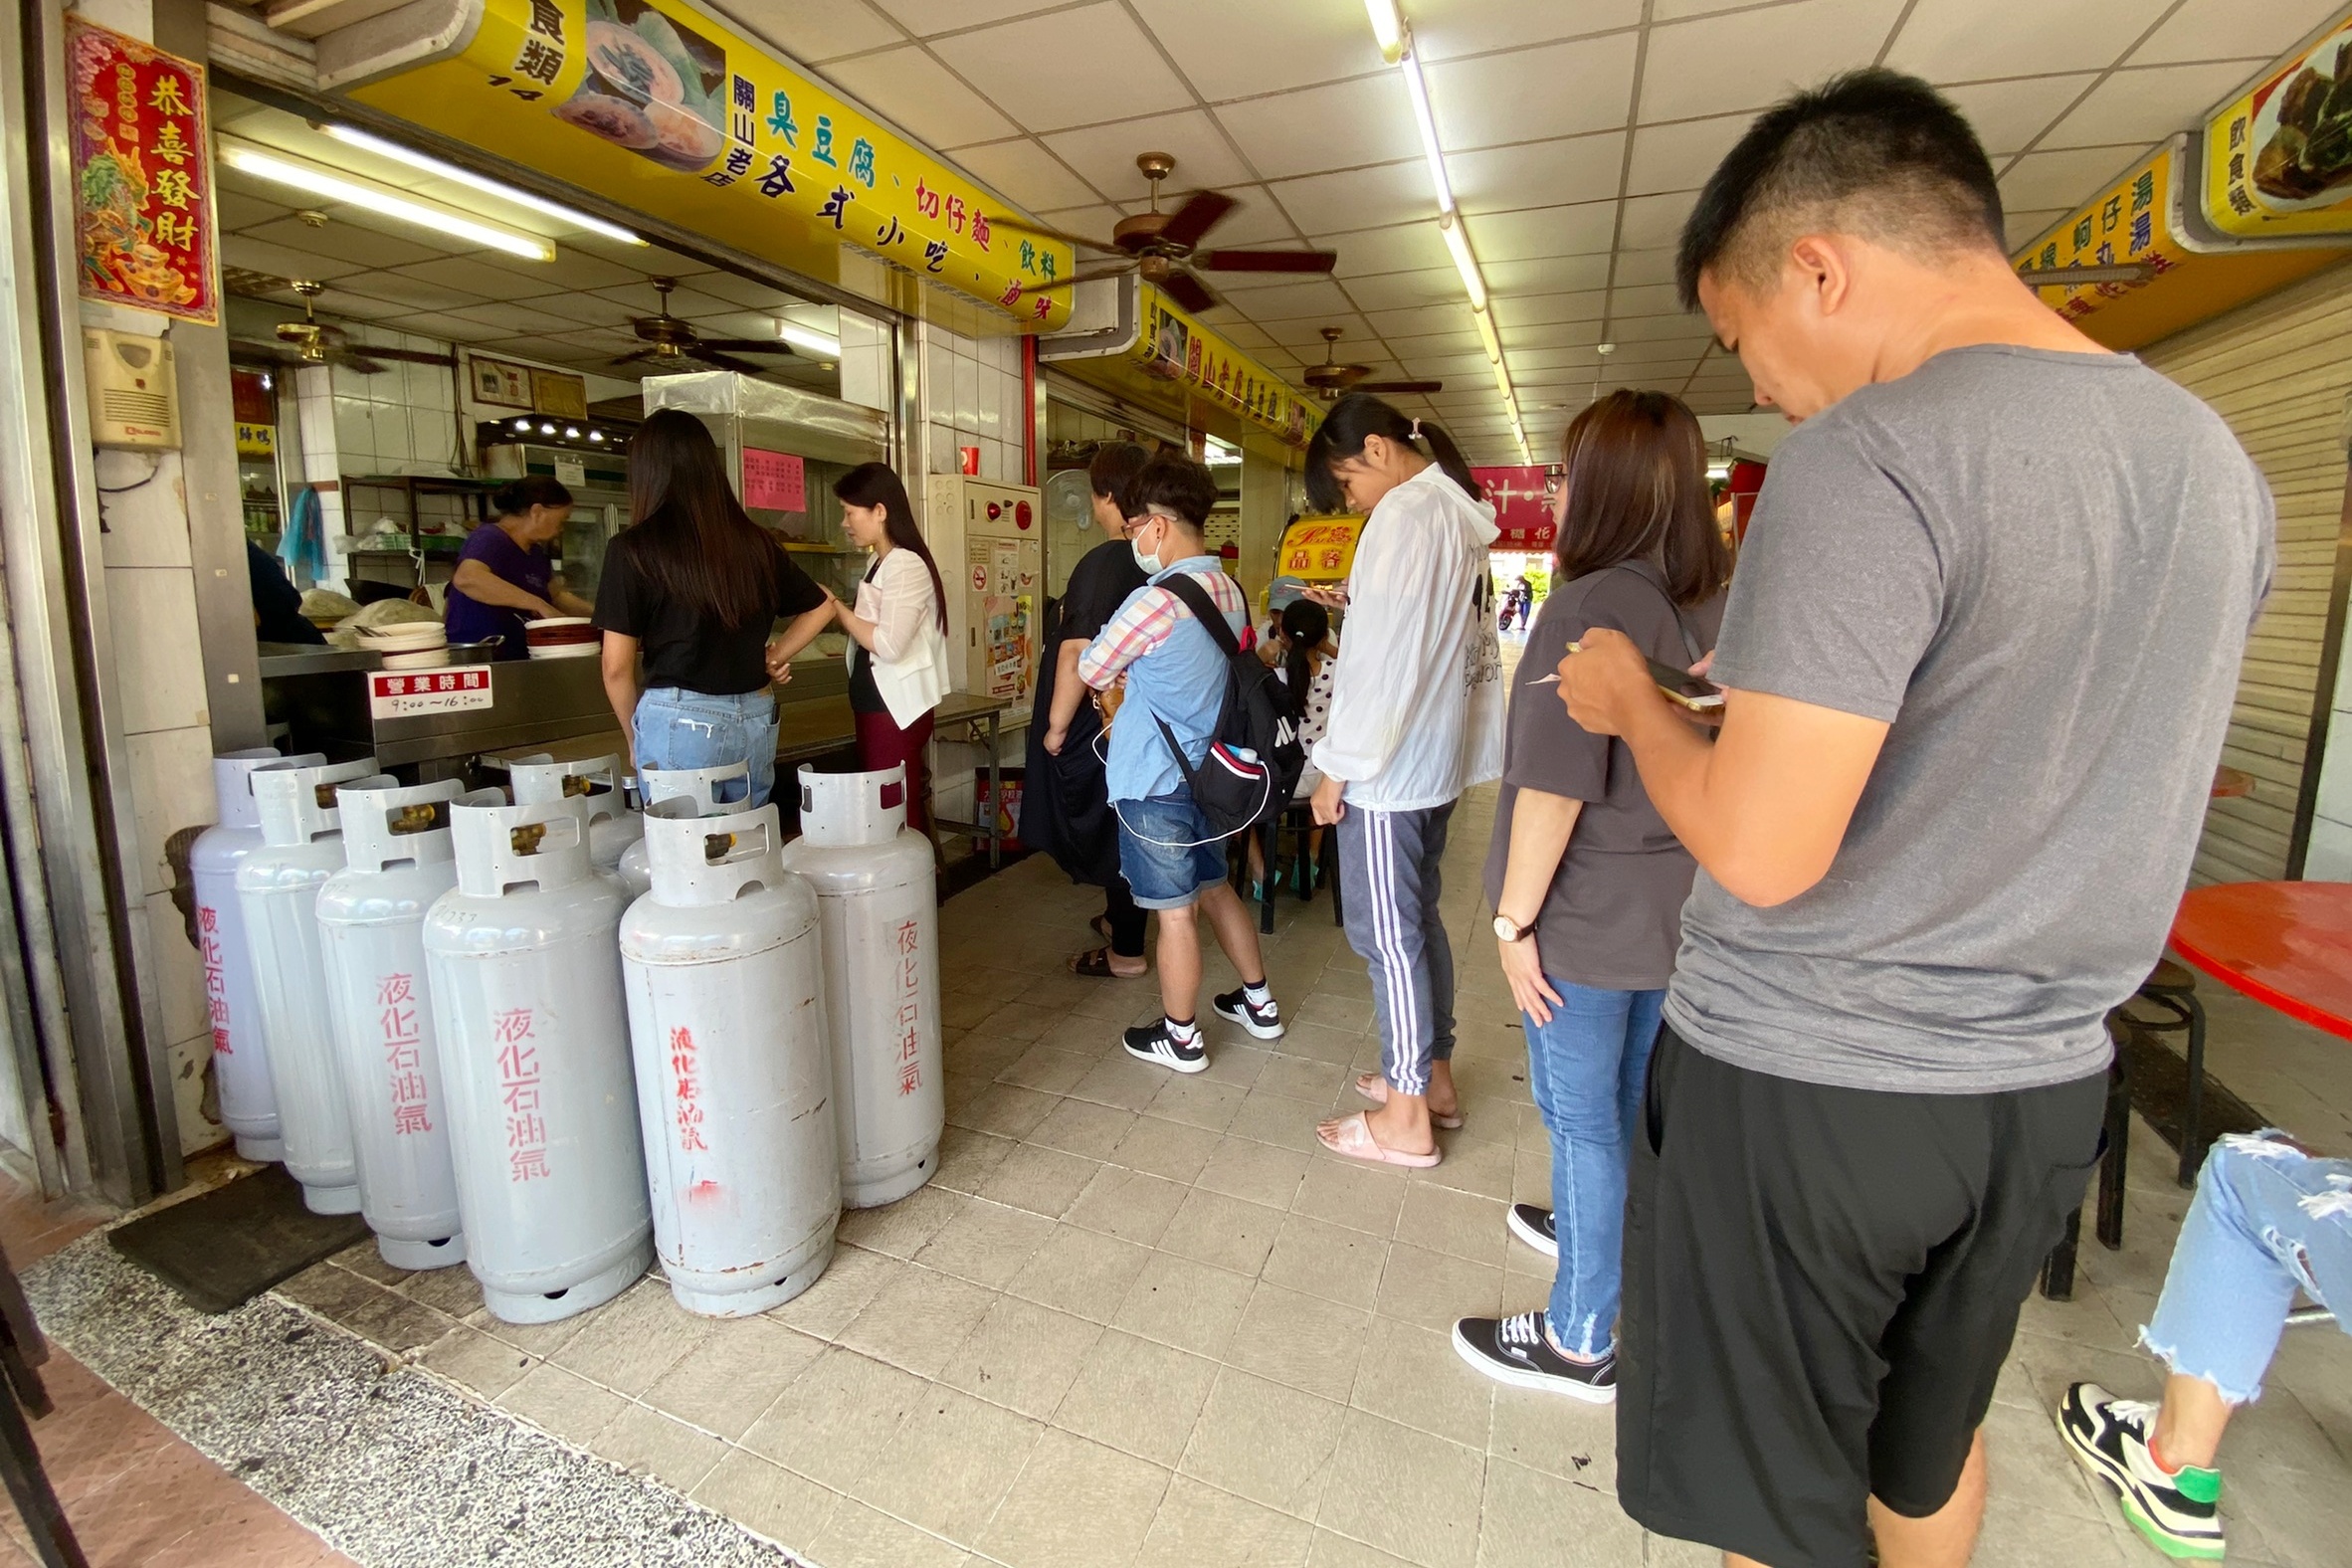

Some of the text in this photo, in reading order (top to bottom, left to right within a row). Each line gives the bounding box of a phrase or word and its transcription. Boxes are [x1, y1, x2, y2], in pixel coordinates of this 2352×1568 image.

[147, 74, 201, 253] 恭喜發財
[699, 75, 755, 188] 關山老店
[387, 673, 480, 694] 營業時間
[200, 905, 233, 1056] 液化石油氣
[376, 972, 433, 1135] 液化石油氣
[494, 1008, 551, 1183] 液化石油氣
